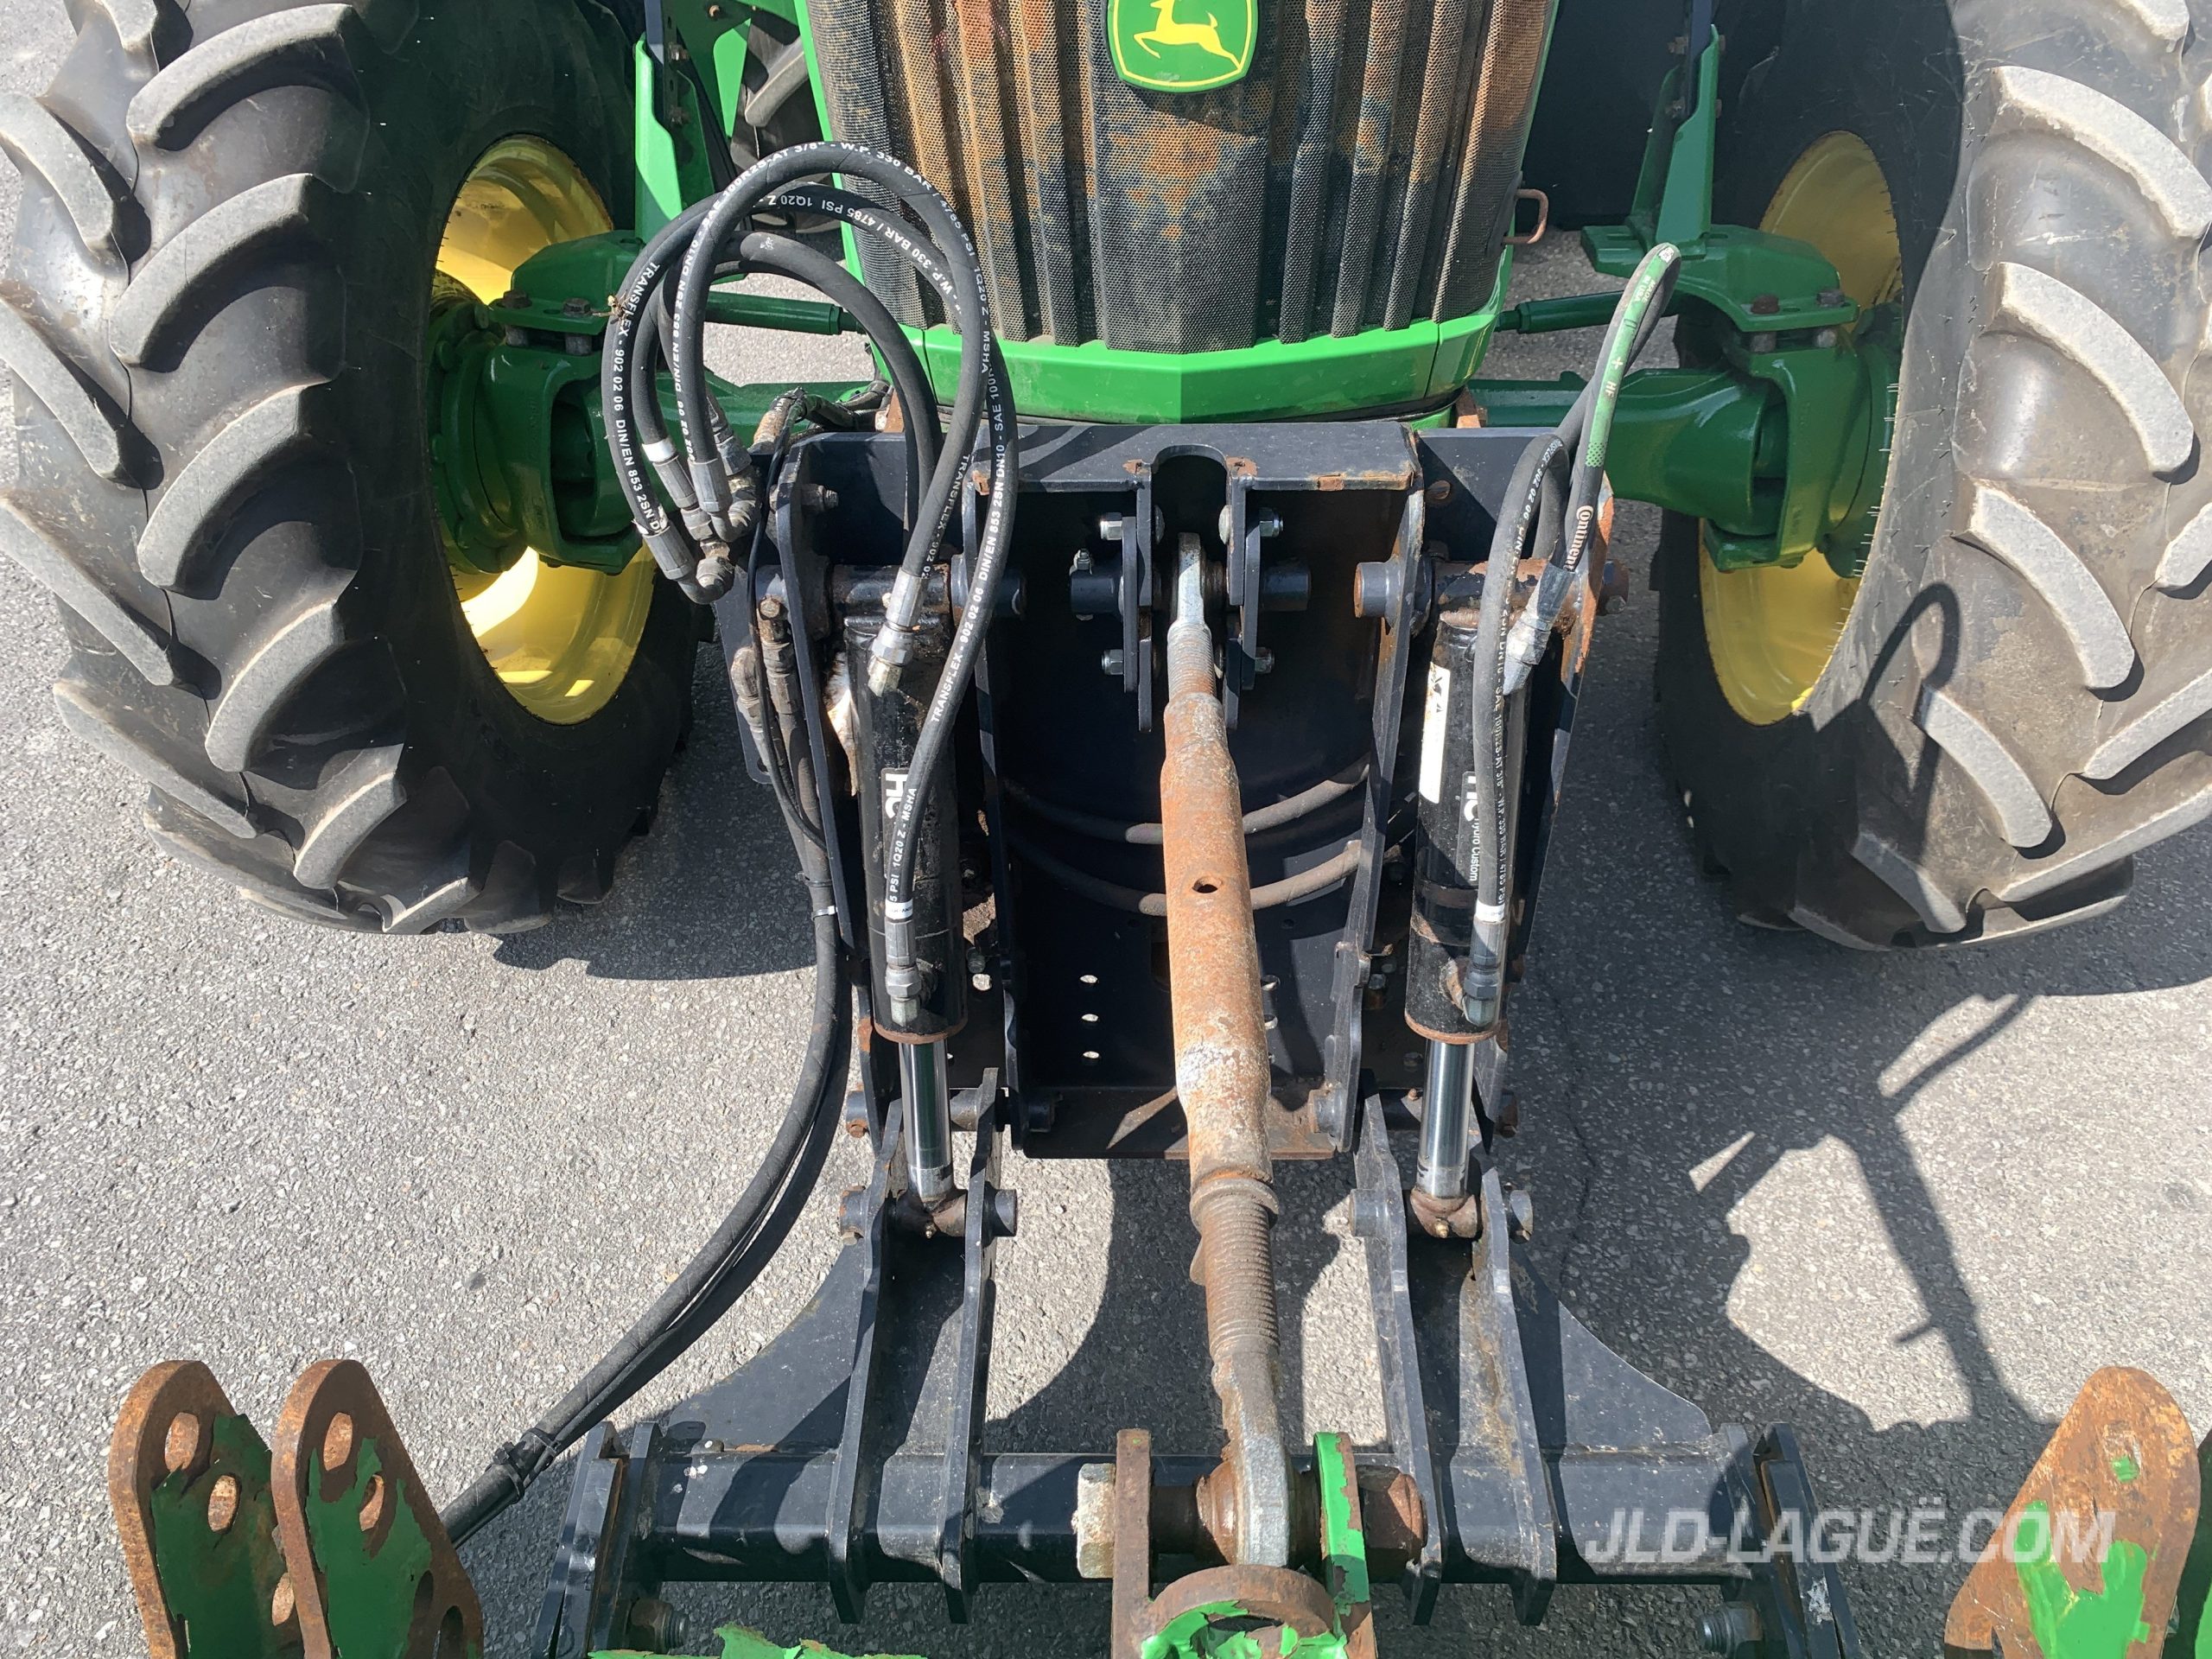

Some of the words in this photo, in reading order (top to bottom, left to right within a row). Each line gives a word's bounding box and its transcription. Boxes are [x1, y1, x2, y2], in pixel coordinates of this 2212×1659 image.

[841, 142, 872, 156] W.P.
[876, 150, 901, 167] 330
[904, 166, 932, 191] BAR
[767, 195, 777, 206] Z
[780, 194, 813, 207] 1Q20
[822, 200, 843, 214] PSI
[702, 200, 721, 230] SAE
[847, 207, 876, 226] 4785
[884, 226, 912, 251] BAR
[960, 232, 976, 257] PSI
[682, 239, 697, 276] DN10
[912, 248, 932, 269] 330
[931, 267, 954, 296] W.P.
[974, 265, 988, 302] 1Q20
[618, 262, 661, 337] TRANSFLEX
[675, 282, 686, 309] 2SN
[672, 314, 681, 338] 853
[613, 349, 625, 372] 902
[981, 331, 990, 374] MSHA
[672, 342, 682, 392] DIN/EN
[613, 377, 623, 391] 02
[613, 396, 624, 411] 06
[993, 404, 1004, 432] SAE
[615, 419, 635, 467] DIN/EN
[995, 444, 1005, 478] DN10
[627, 469, 643, 492] 853
[938, 454, 971, 531] TRANSFLEX
[636, 493, 655, 519] 2SN
[994, 480, 1004, 508] 2SN
[988, 510, 1001, 535] 853
[926, 540, 939, 563] 902
[978, 536, 997, 582] DIN/EN
[973, 587, 984, 603] 06
[968, 604, 980, 620] 02
[959, 621, 975, 644] 902
[931, 652, 963, 723] TRANSFLEX
[901, 787, 918, 821] MSHA
[897, 830, 906, 839] Z
[892, 841, 905, 868] 1Q20
[1469, 846, 1480, 881] Custom
[889, 874, 899, 893] PSI
